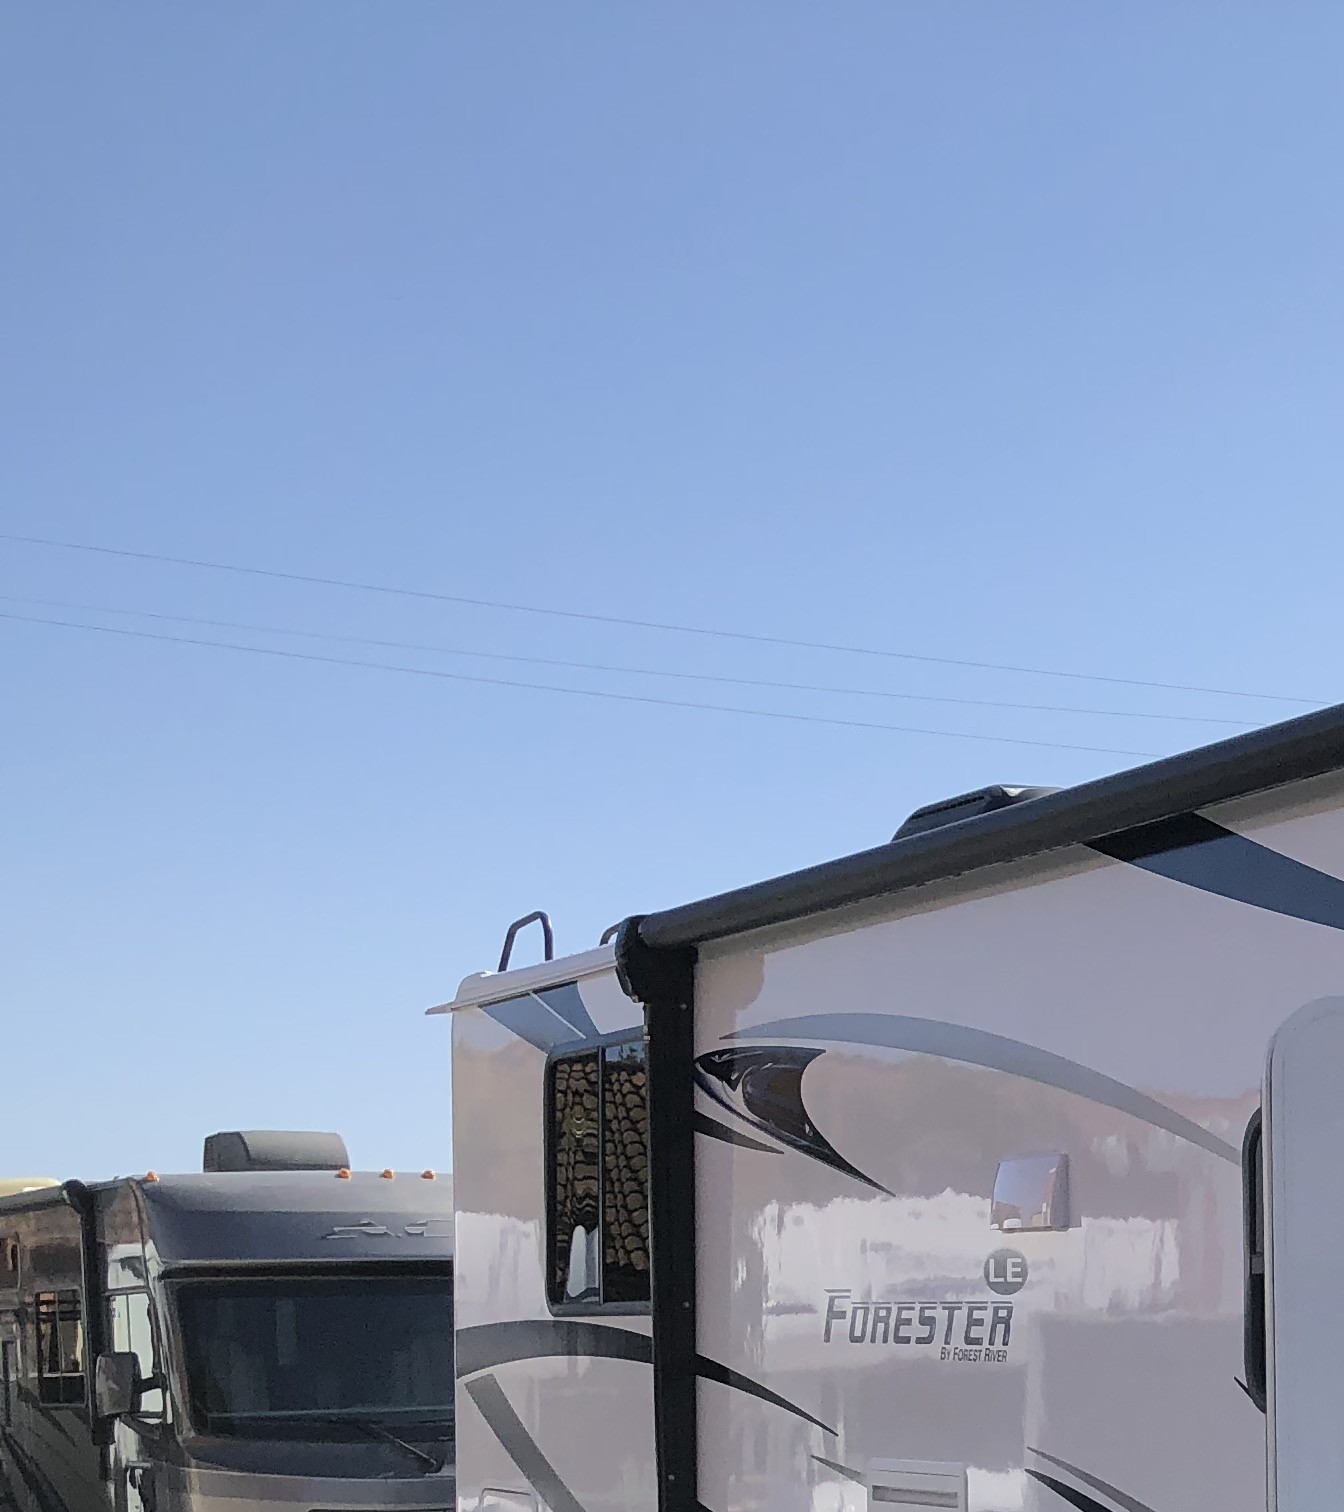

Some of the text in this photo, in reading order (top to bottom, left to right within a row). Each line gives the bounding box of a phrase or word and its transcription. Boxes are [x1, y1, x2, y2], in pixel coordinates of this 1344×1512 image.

[988, 1257, 1023, 1283] LE
[823, 1288, 1015, 1347] FORESTER
[940, 1346, 1008, 1363] BY FOREST RIVER
